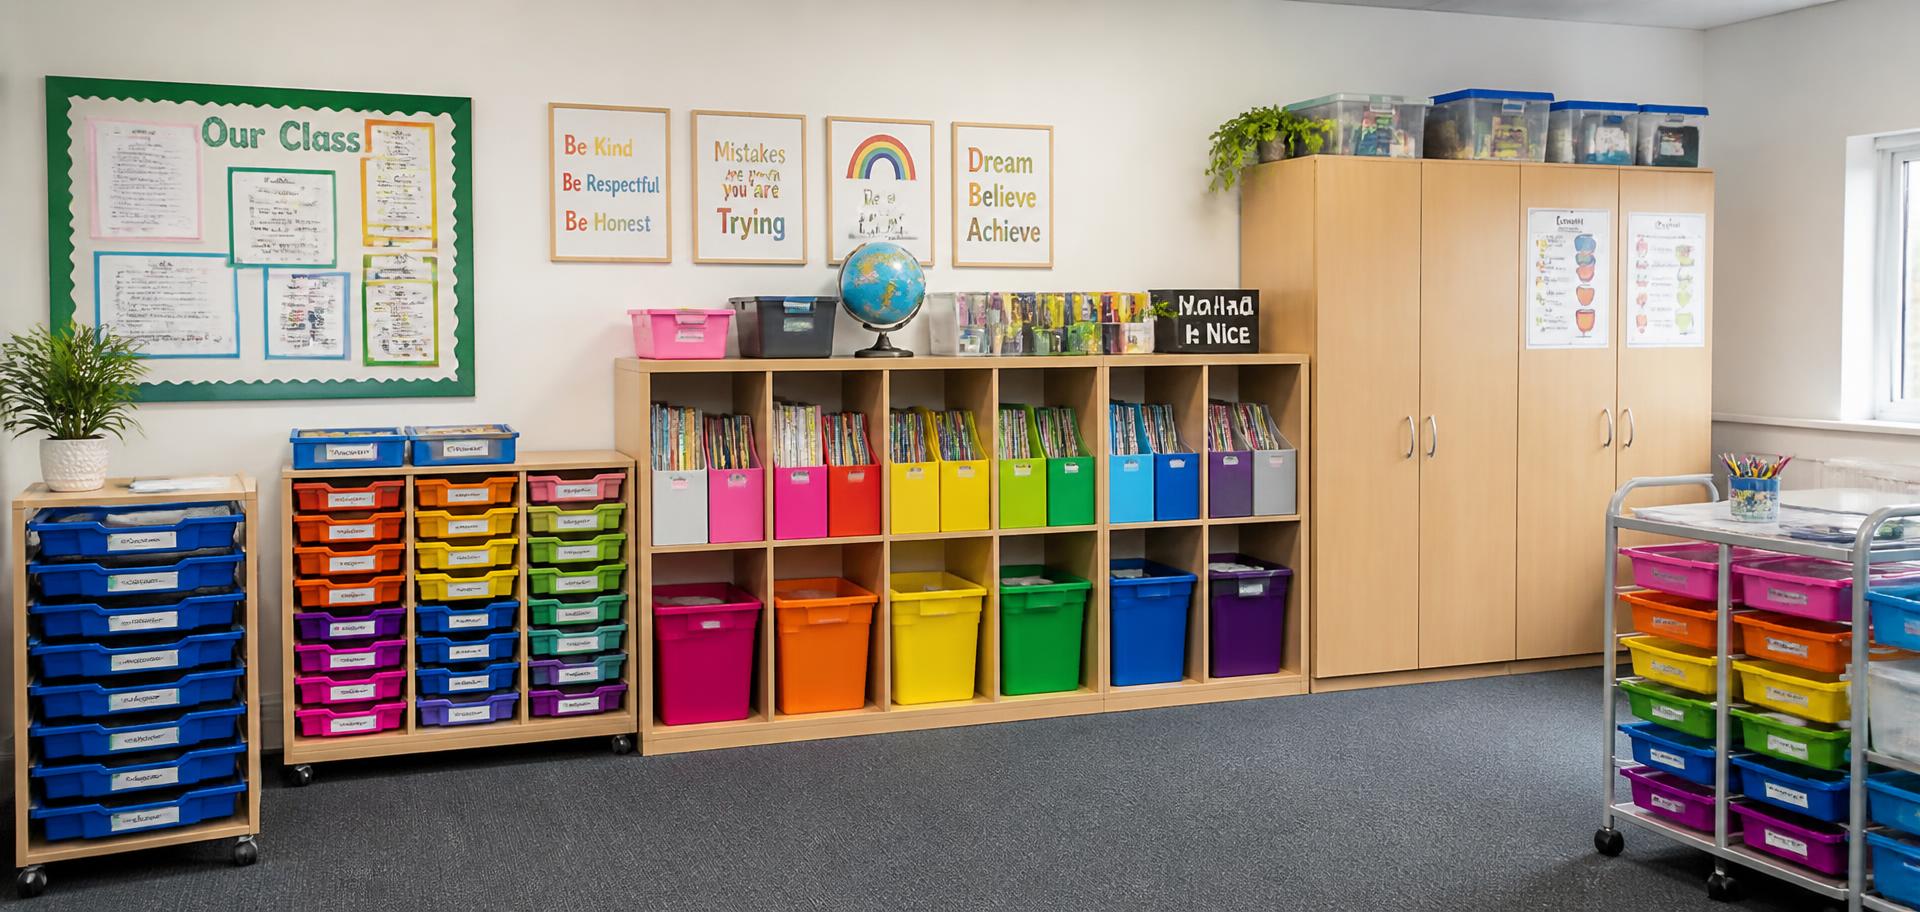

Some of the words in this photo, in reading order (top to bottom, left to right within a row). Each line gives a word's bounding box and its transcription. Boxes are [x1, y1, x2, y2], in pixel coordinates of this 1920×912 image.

[202, 116, 266, 148] Our
[279, 120, 361, 153] Class
[564, 134, 587, 156] Be
[594, 136, 633, 157] Kind
[714, 140, 786, 164] Mistakes
[967, 147, 1033, 174] Dream
[563, 172, 582, 192] Be
[587, 174, 660, 198] Respectful
[723, 183, 747, 201] you
[753, 183, 779, 199] are
[968, 182, 1037, 208] Believe
[565, 210, 588, 232] Be
[594, 212, 651, 232] Honest
[716, 207, 785, 241] Trying
[966, 217, 1041, 242] Achieve
